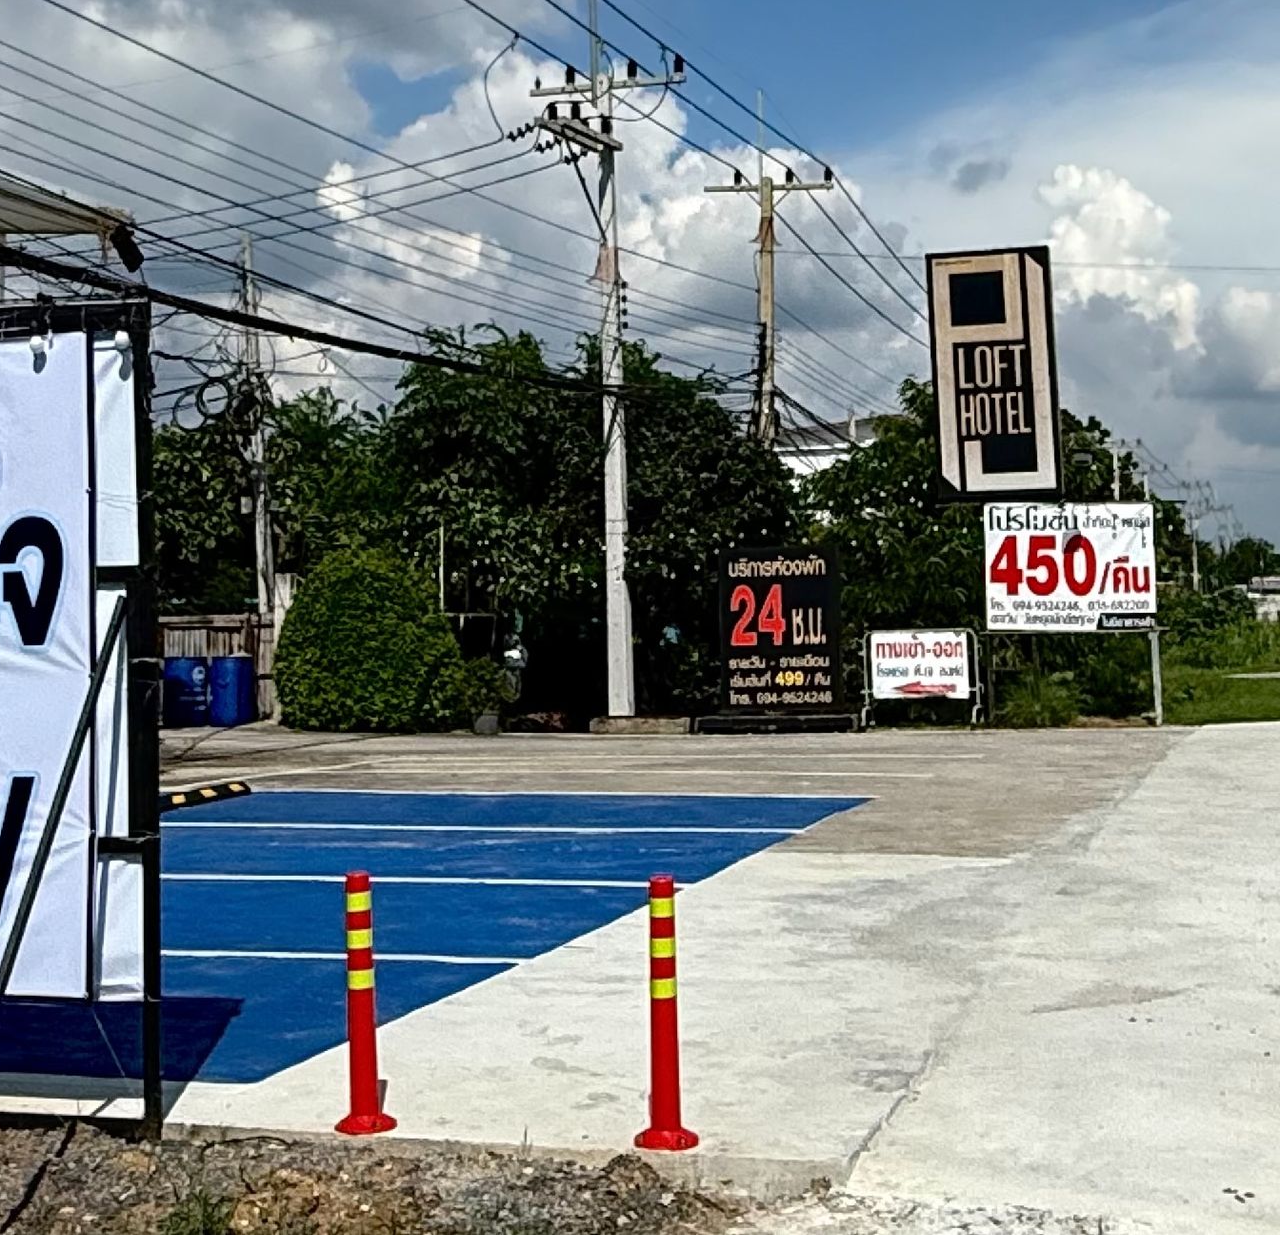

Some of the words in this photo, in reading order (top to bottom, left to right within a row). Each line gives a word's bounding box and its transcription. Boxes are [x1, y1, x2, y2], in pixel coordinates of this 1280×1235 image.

[957, 344, 1026, 389] LOFT
[959, 391, 1032, 436] HOTEL
[728, 554, 827, 577] บริการห้องพัก
[730, 584, 786, 646] 24
